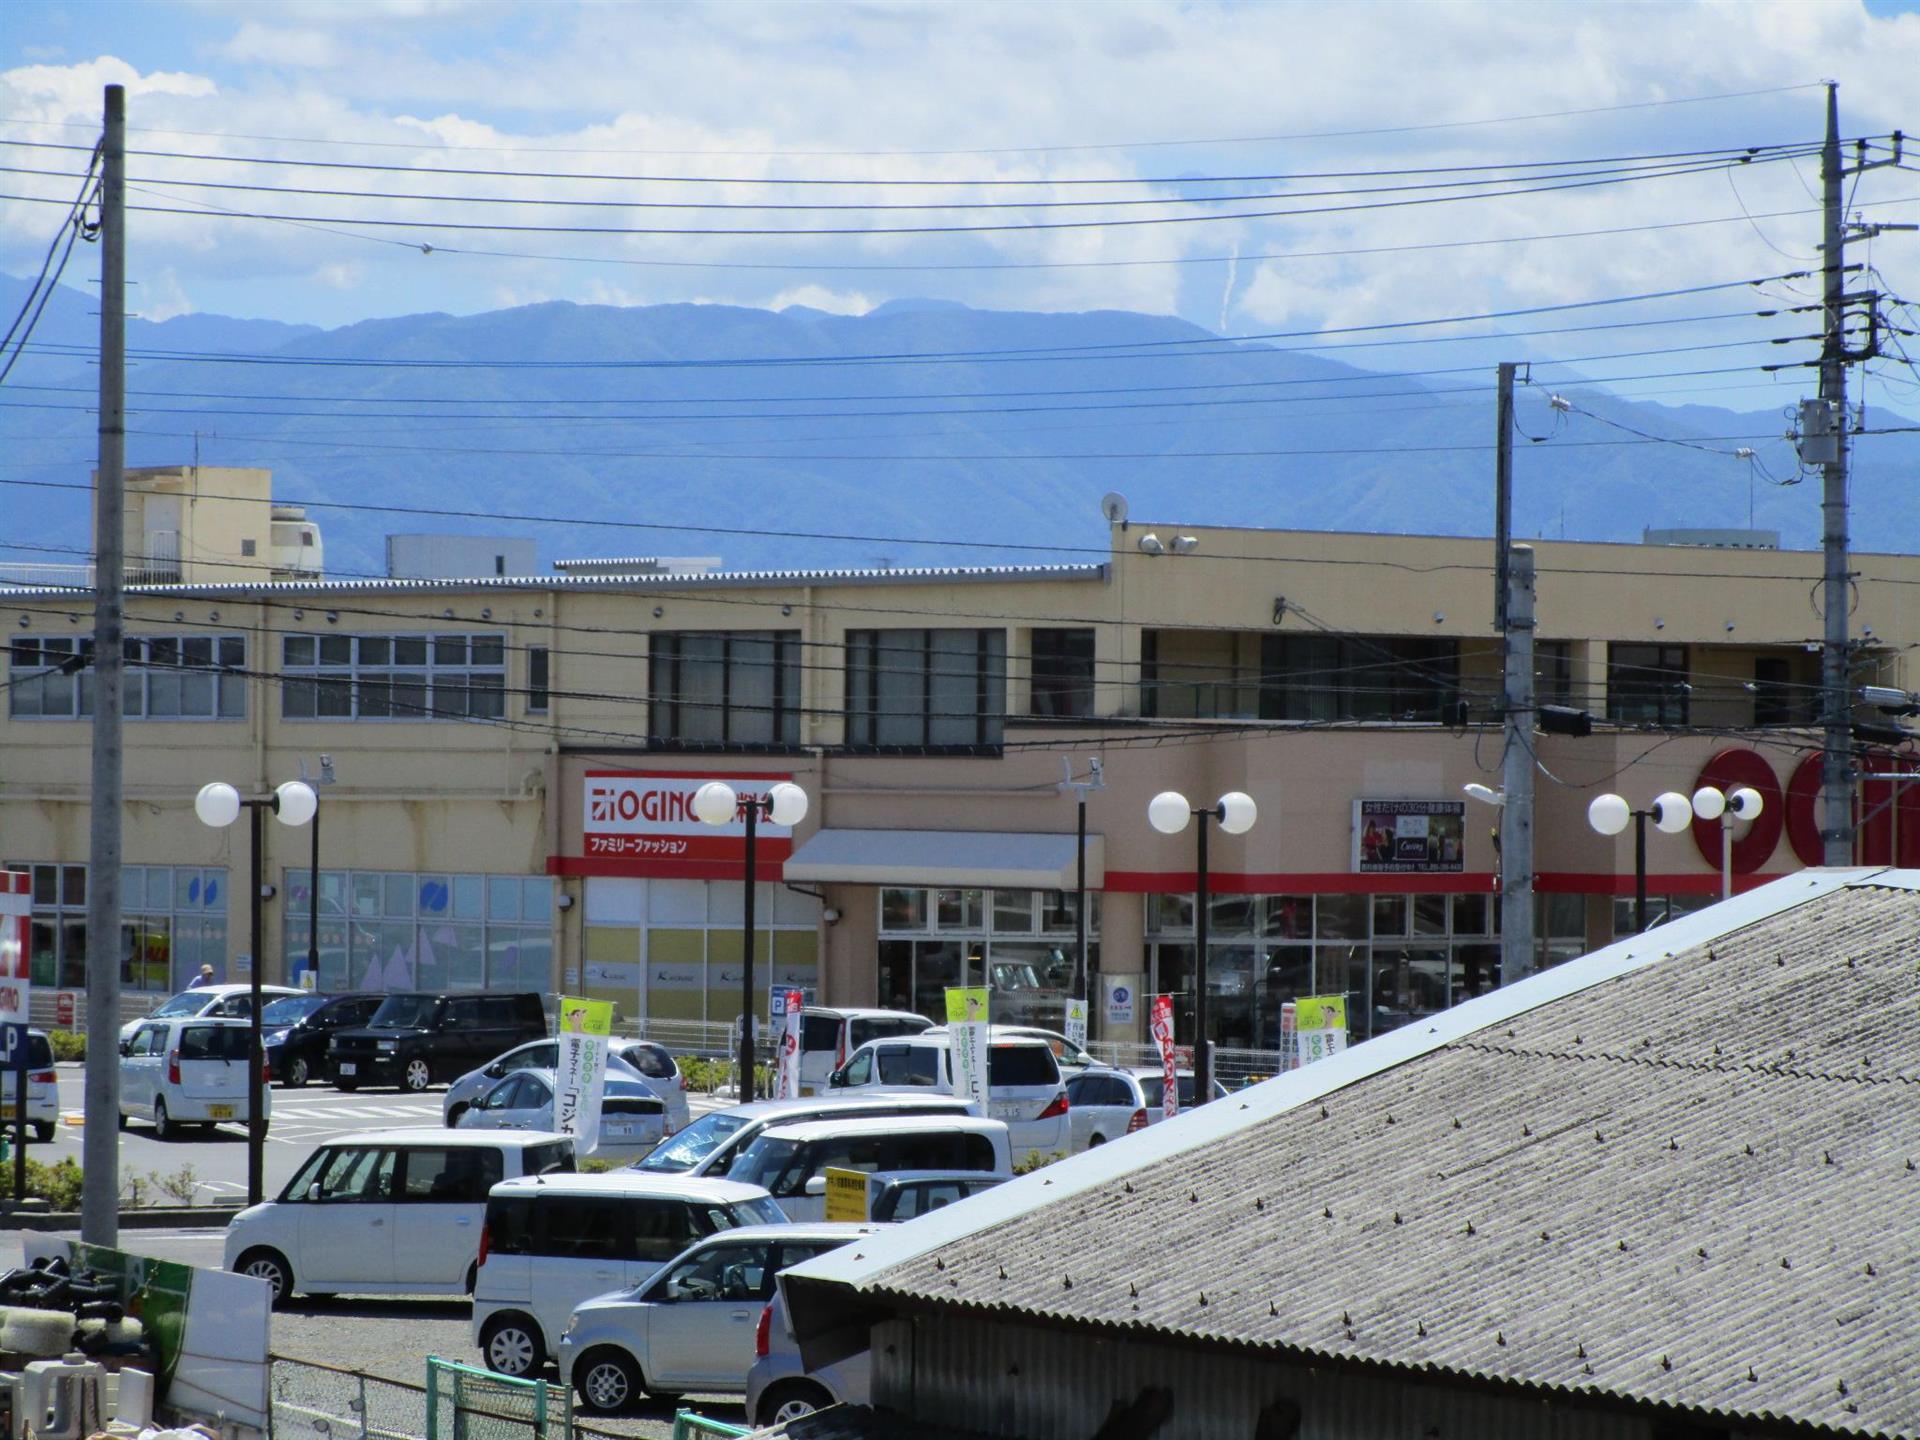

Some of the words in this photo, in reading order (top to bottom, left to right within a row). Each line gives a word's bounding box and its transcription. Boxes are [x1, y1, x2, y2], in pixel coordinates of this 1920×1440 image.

[590, 838, 687, 854] ファミリーファッション
[775, 1000, 782, 1011] P
